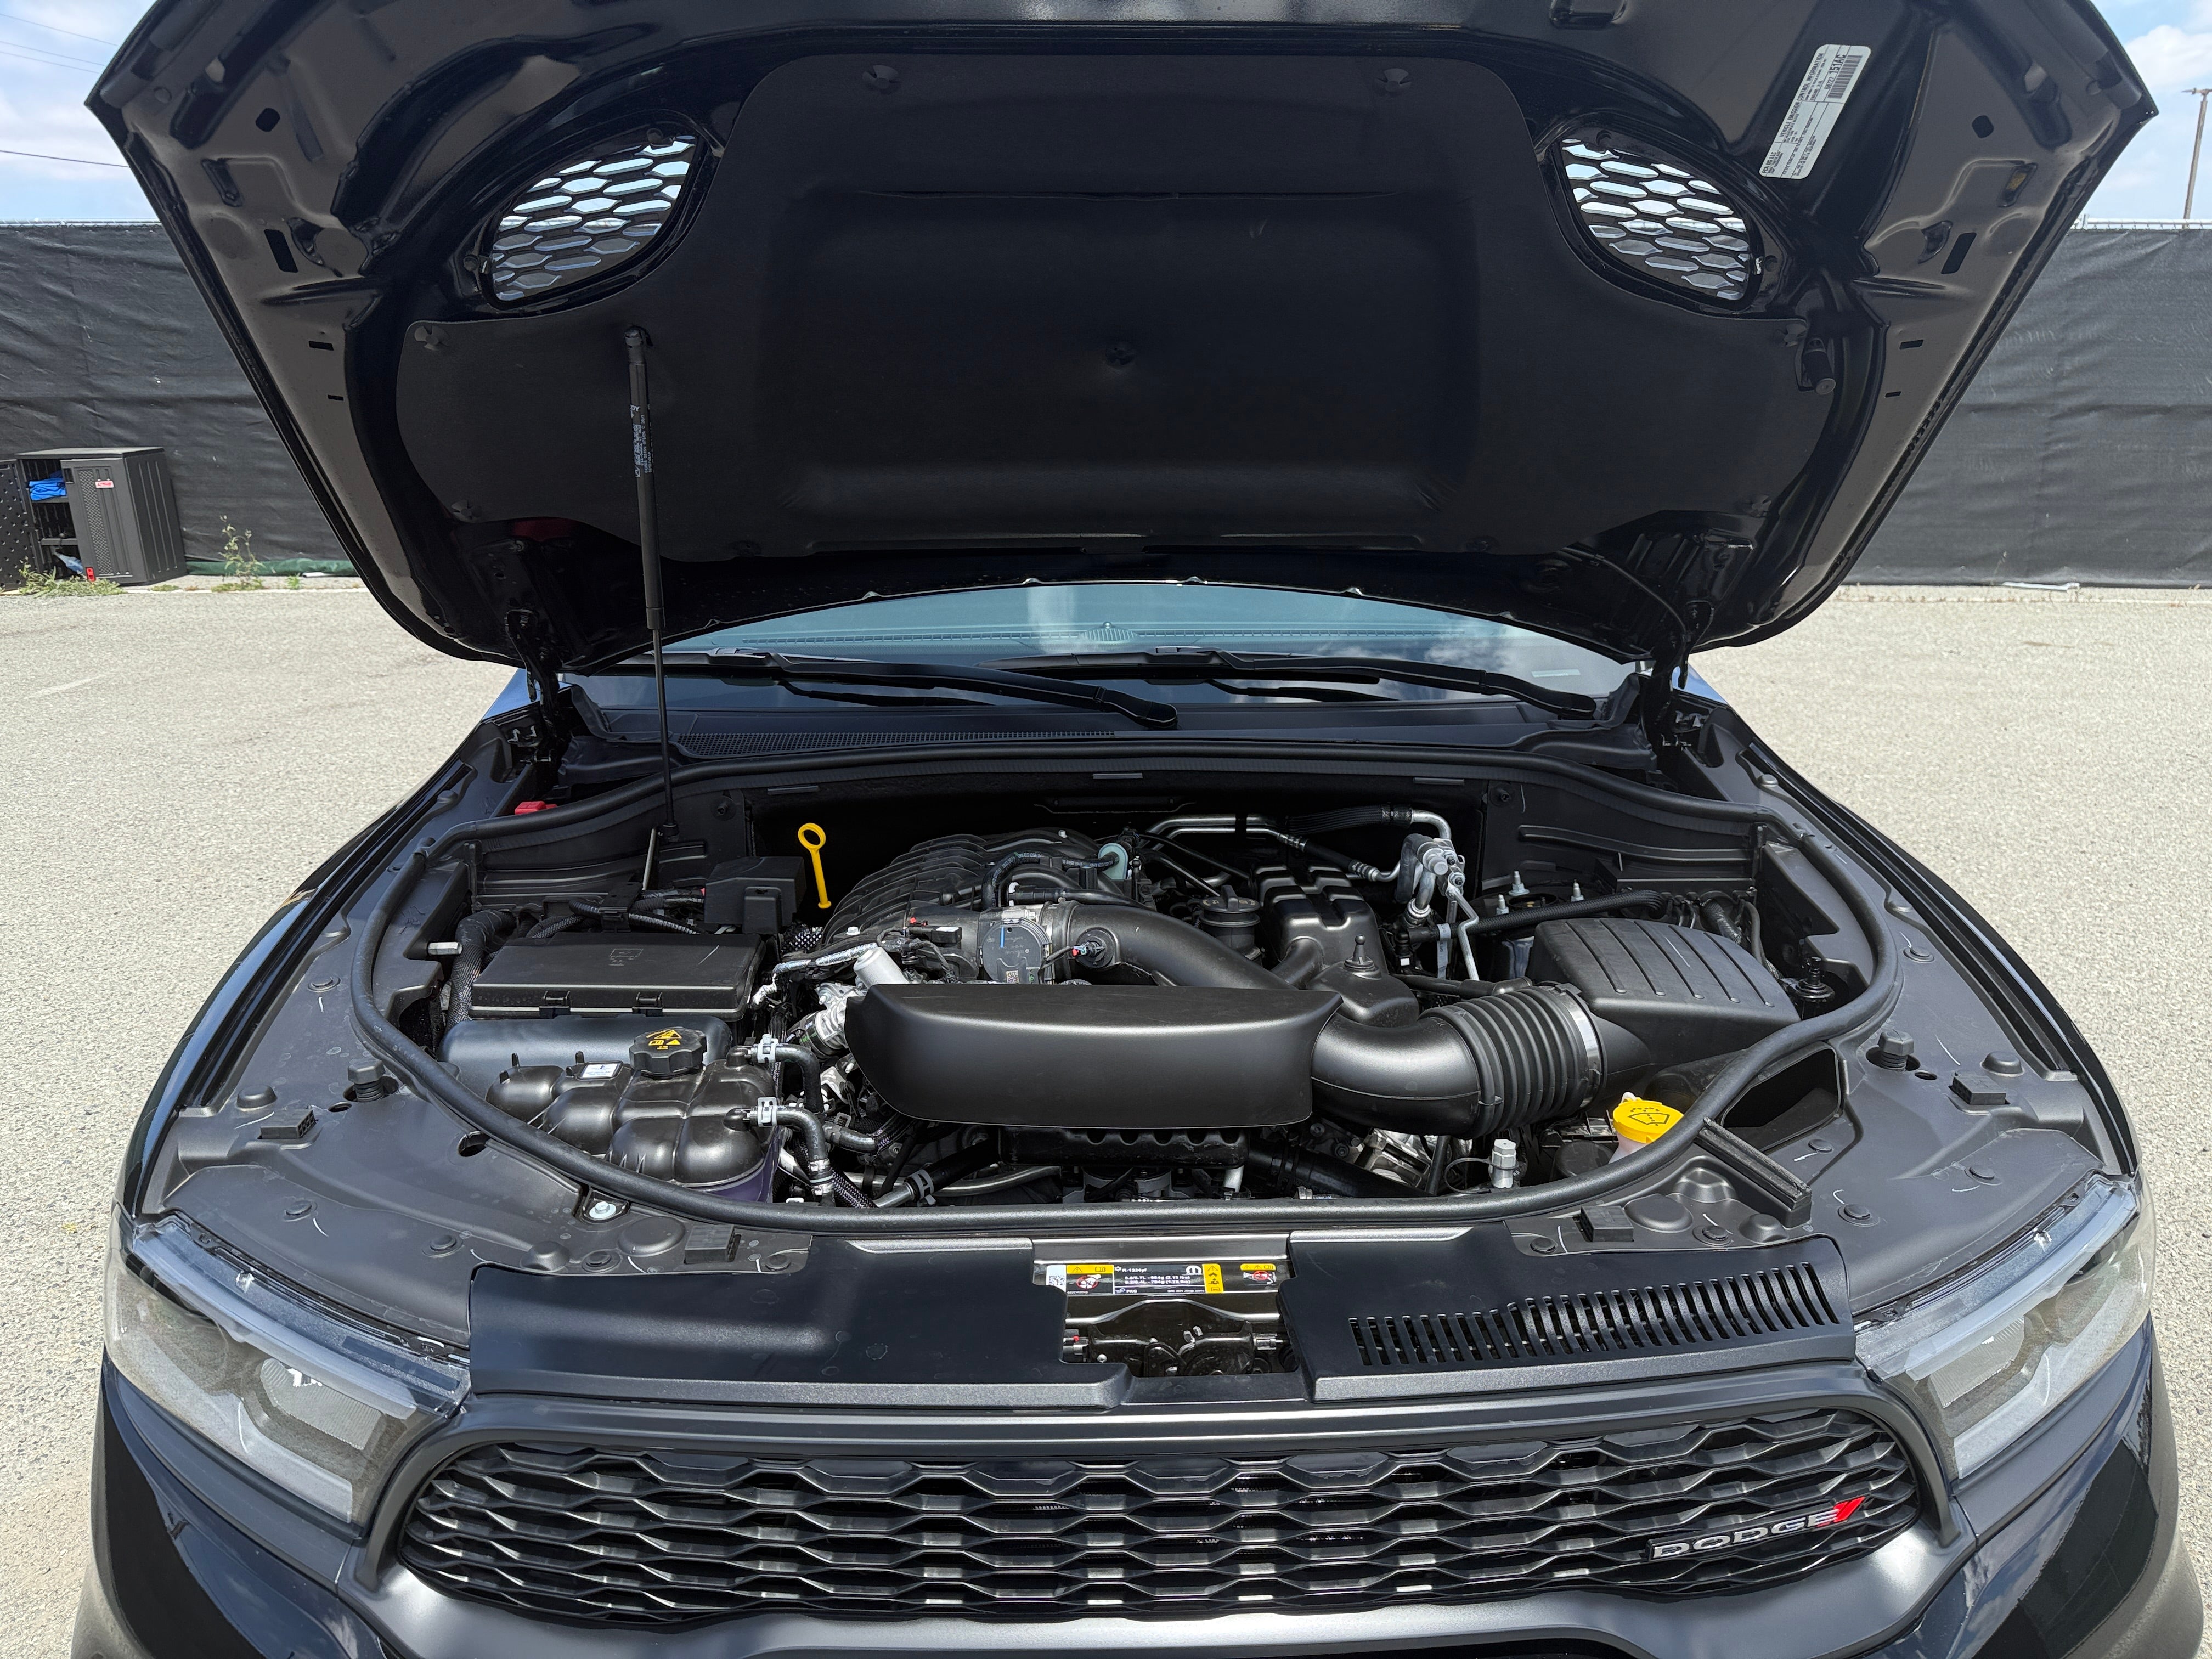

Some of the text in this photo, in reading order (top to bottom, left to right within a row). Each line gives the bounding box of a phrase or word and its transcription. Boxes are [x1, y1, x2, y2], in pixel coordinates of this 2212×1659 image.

[1829, 54, 1846, 74] 151AC
[1780, 121, 1791, 137] VEHICLE
[1788, 101, 1800, 120] EMISSION
[1797, 83, 1810, 100] CONTROL
[1807, 53, 1824, 81] INFORMATION
[1652, 1509, 1839, 1559] DODGE
